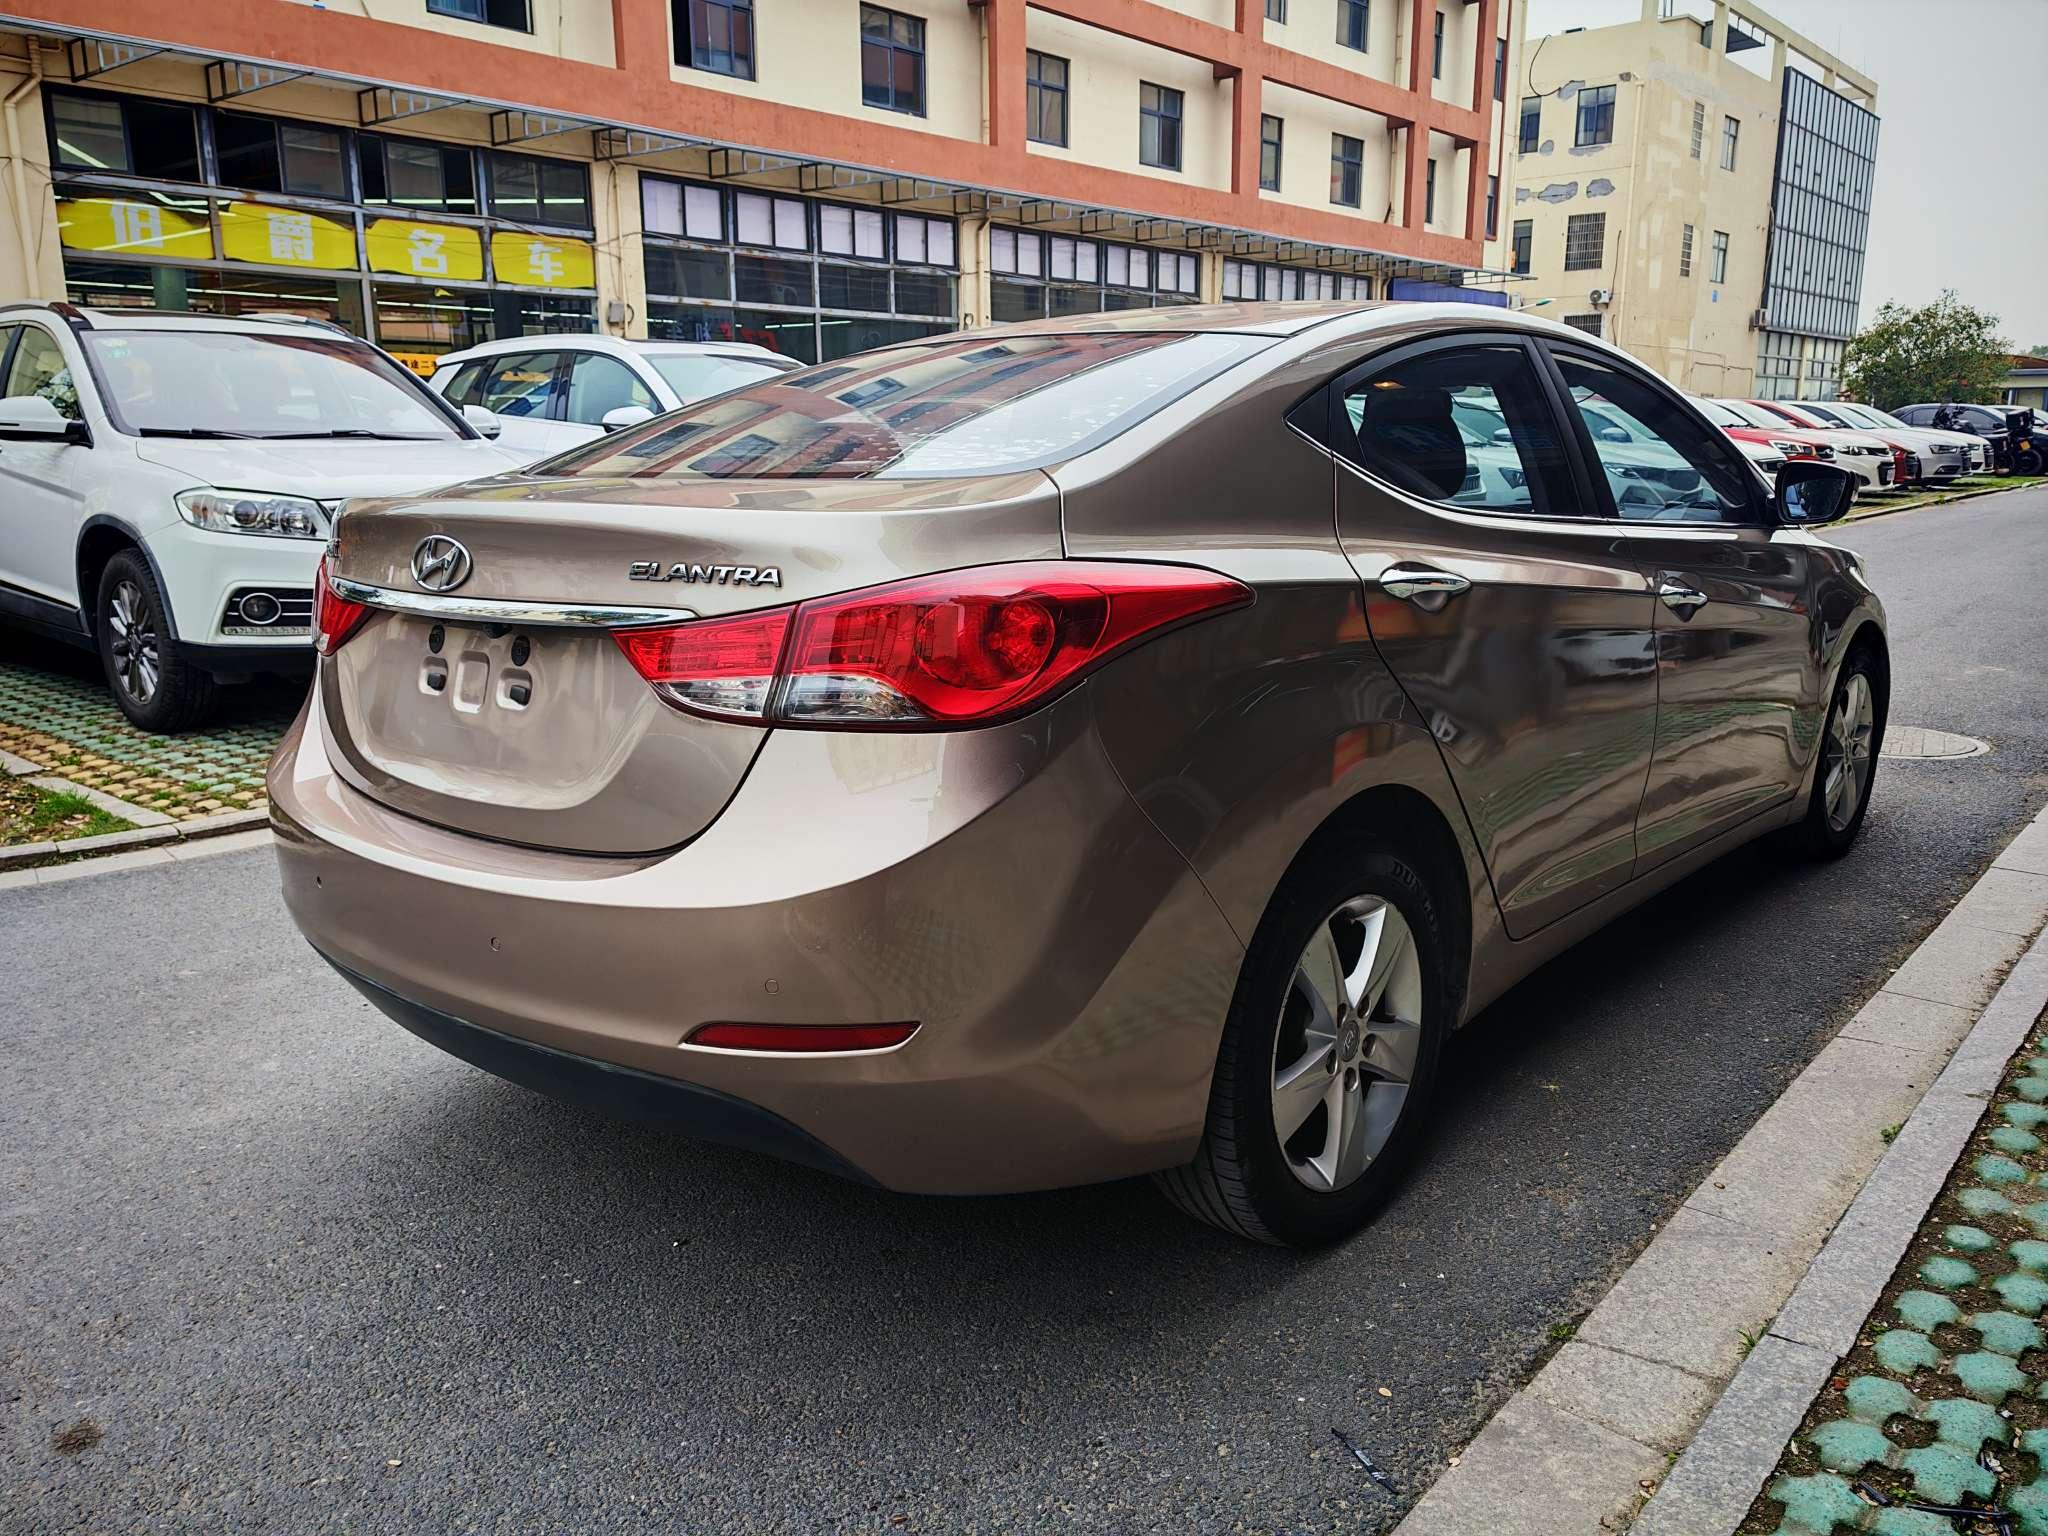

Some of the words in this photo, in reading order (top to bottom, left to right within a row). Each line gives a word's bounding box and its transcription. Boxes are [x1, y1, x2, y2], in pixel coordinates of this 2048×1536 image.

[109, 198, 564, 282] 伯爵名车
[629, 560, 782, 588] ELANTRA
